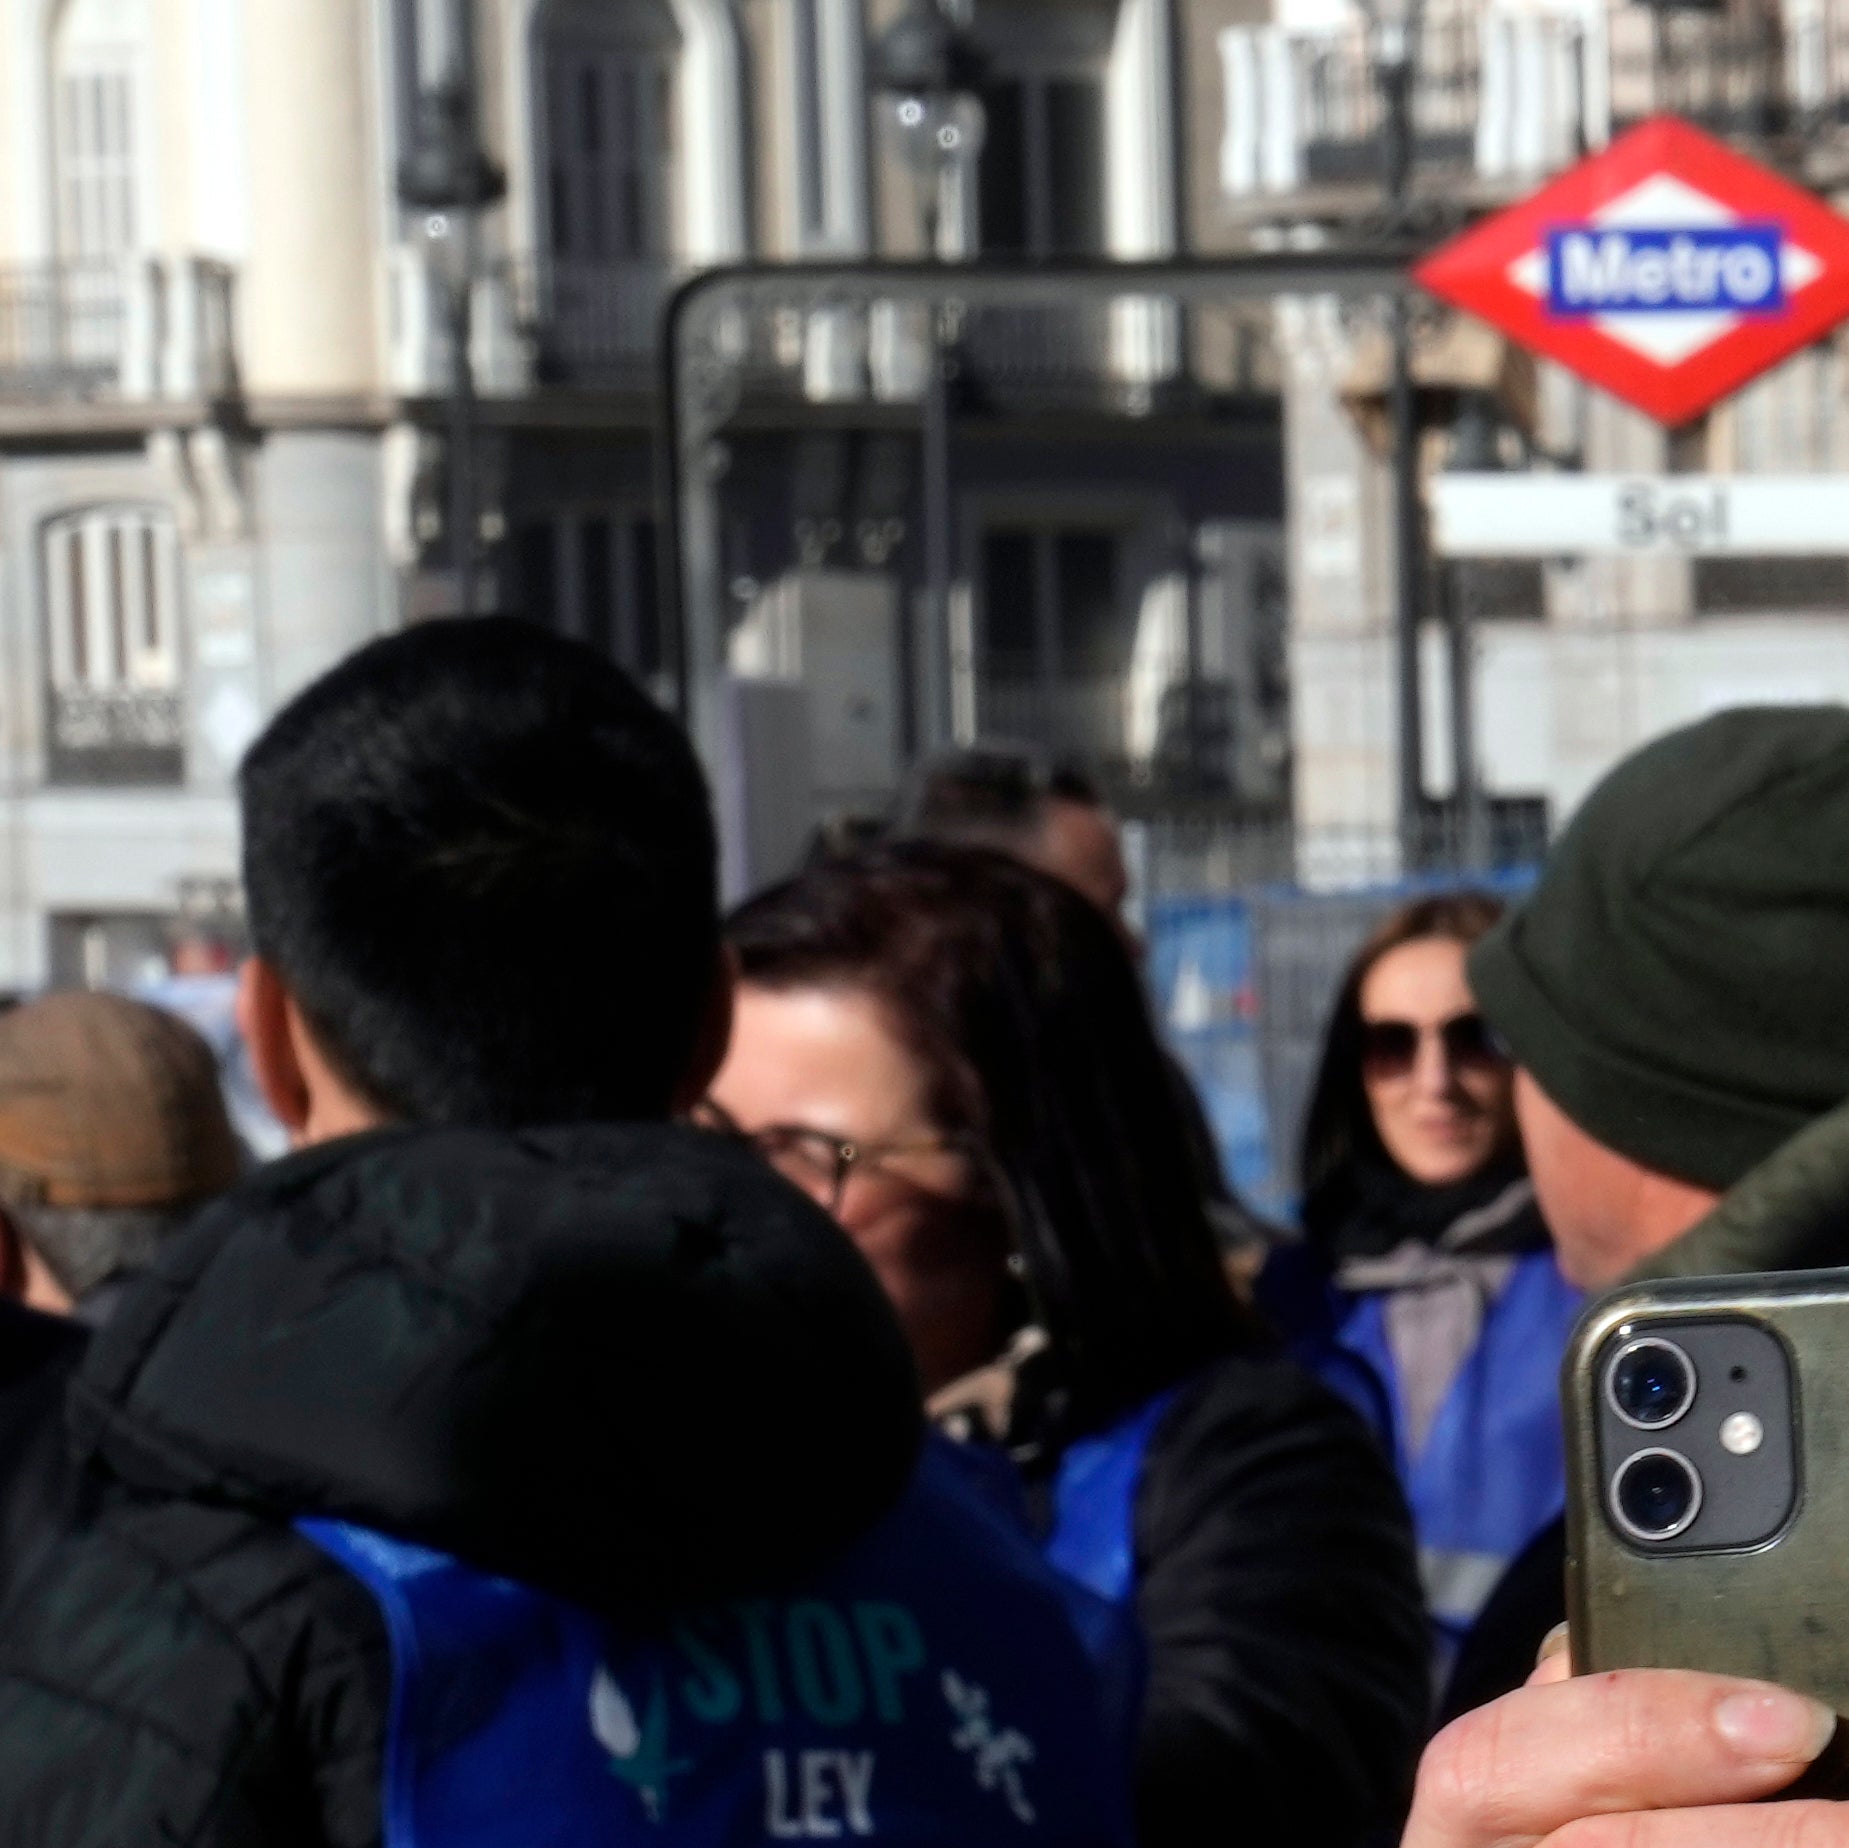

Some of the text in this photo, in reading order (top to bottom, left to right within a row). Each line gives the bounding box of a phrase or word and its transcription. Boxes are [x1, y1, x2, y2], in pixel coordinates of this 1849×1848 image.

[1558, 231, 1775, 305] Metro
[1613, 482, 1729, 548] Sol
[675, 1598, 927, 1726] STOP
[761, 1747, 877, 1839] LEY
